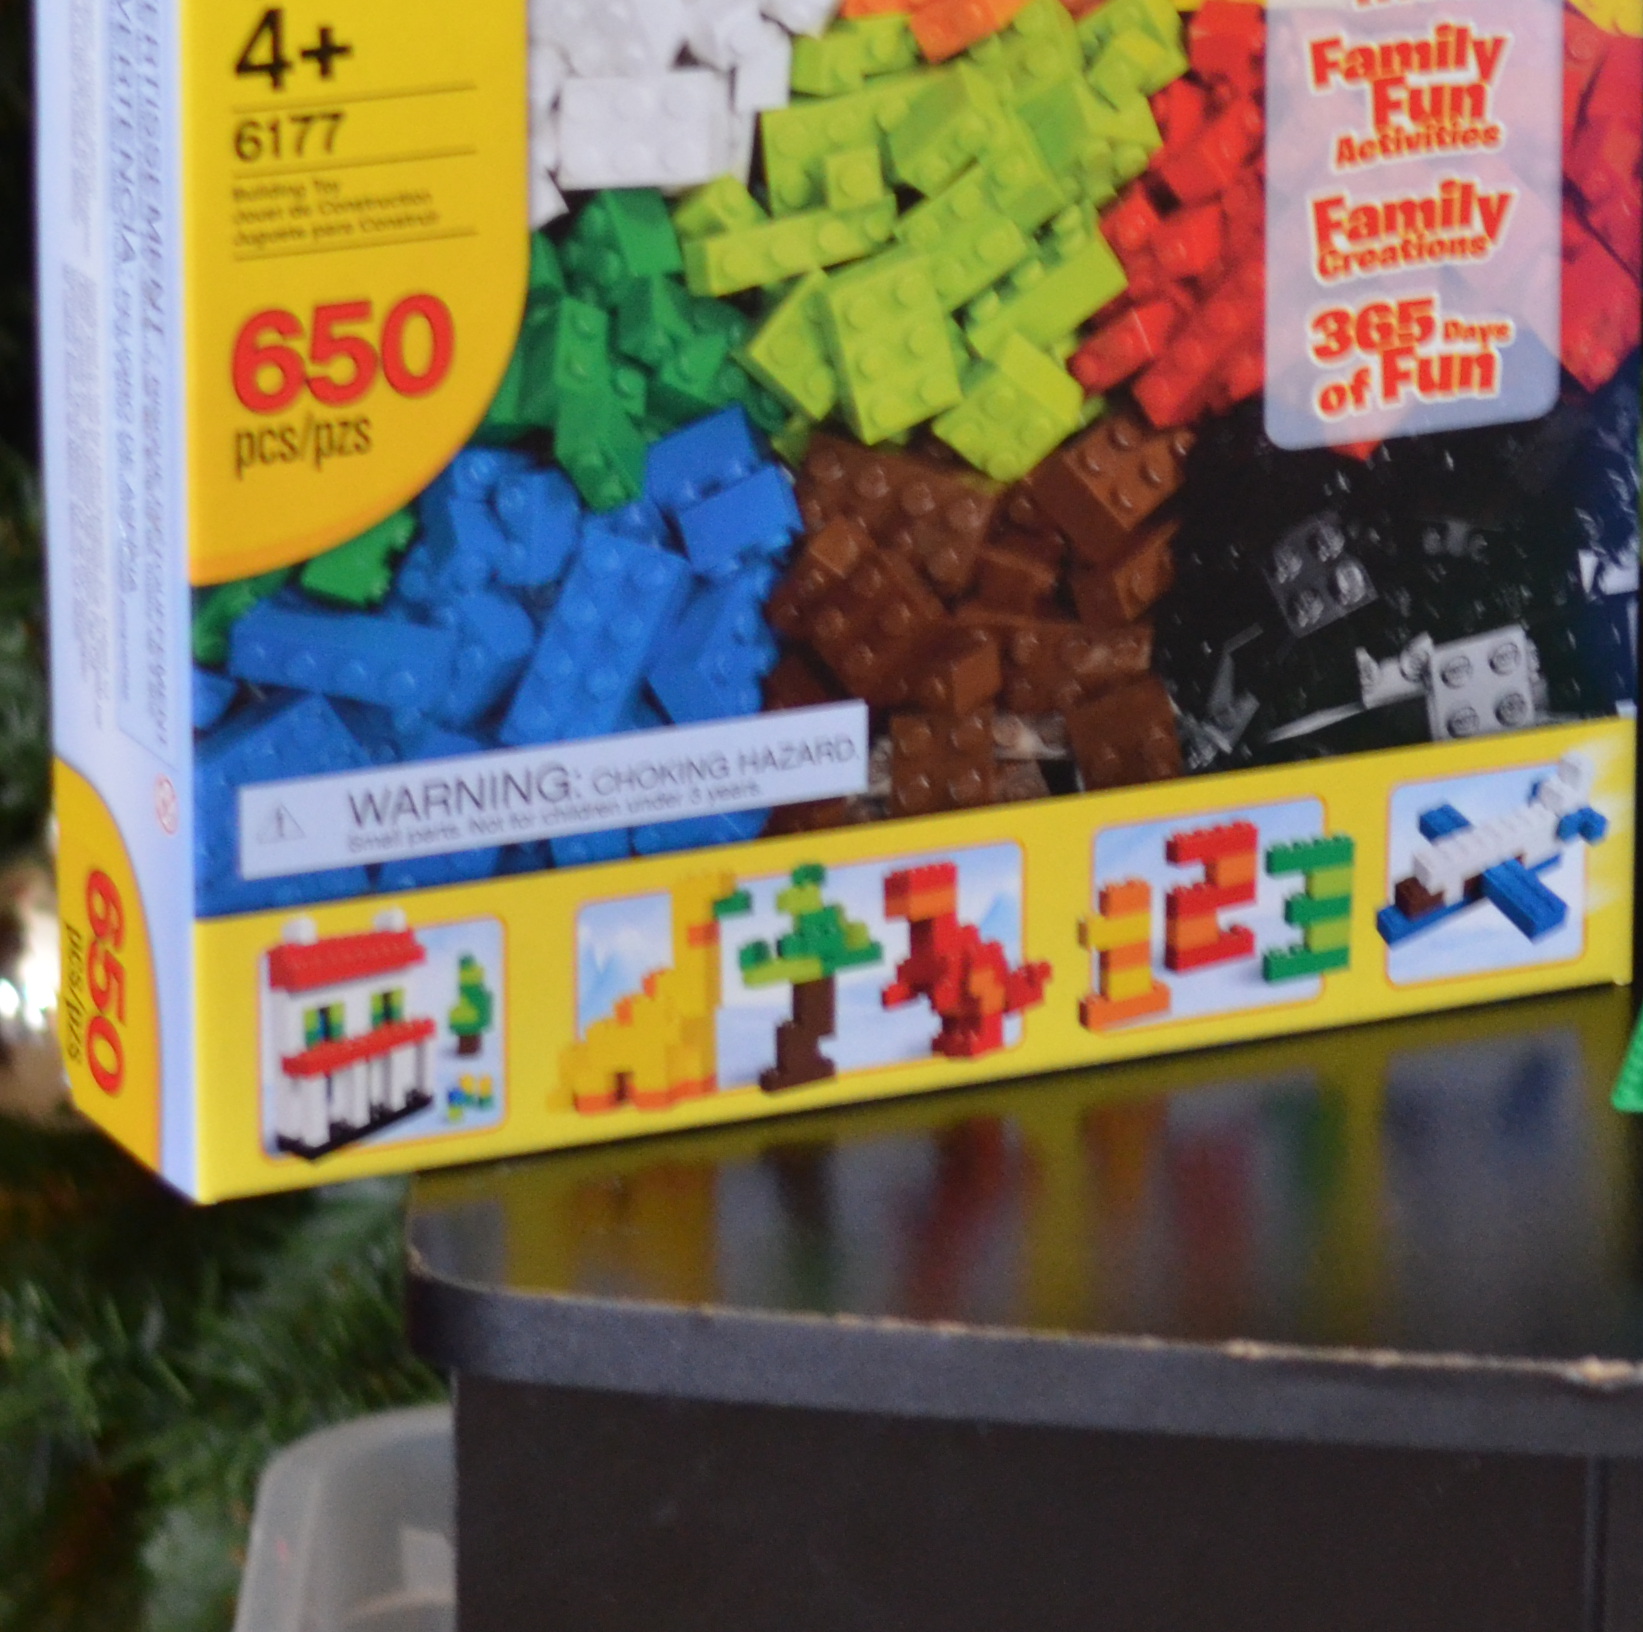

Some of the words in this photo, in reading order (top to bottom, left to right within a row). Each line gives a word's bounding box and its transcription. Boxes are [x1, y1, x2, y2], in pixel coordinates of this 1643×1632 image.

[233, 6, 353, 93] 4+
[1309, 22, 1509, 90] Family
[232, 110, 346, 164] 6177
[1370, 73, 1488, 133] Fun
[1335, 124, 1501, 168] Activities
[1311, 178, 1515, 248] Family
[1317, 233, 1491, 280] Creations
[230, 294, 455, 415] 650
[1311, 297, 1436, 361] 365
[1443, 319, 1512, 352] Days
[1317, 367, 1371, 415] of
[1380, 345, 1497, 401] Fun
[234, 411, 372, 482] pcs/pzs
[346, 759, 583, 829] WARNING:
[592, 748, 730, 798] CHOKING
[738, 733, 860, 779] HAZARD.
[346, 824, 404, 853] Small
[471, 812, 501, 836] Not
[542, 800, 623, 828] children
[628, 792, 682, 816] under
[689, 787, 702, 809] 3
[62, 918, 86, 1066] pcs/pzs
[85, 867, 126, 1098] 650
